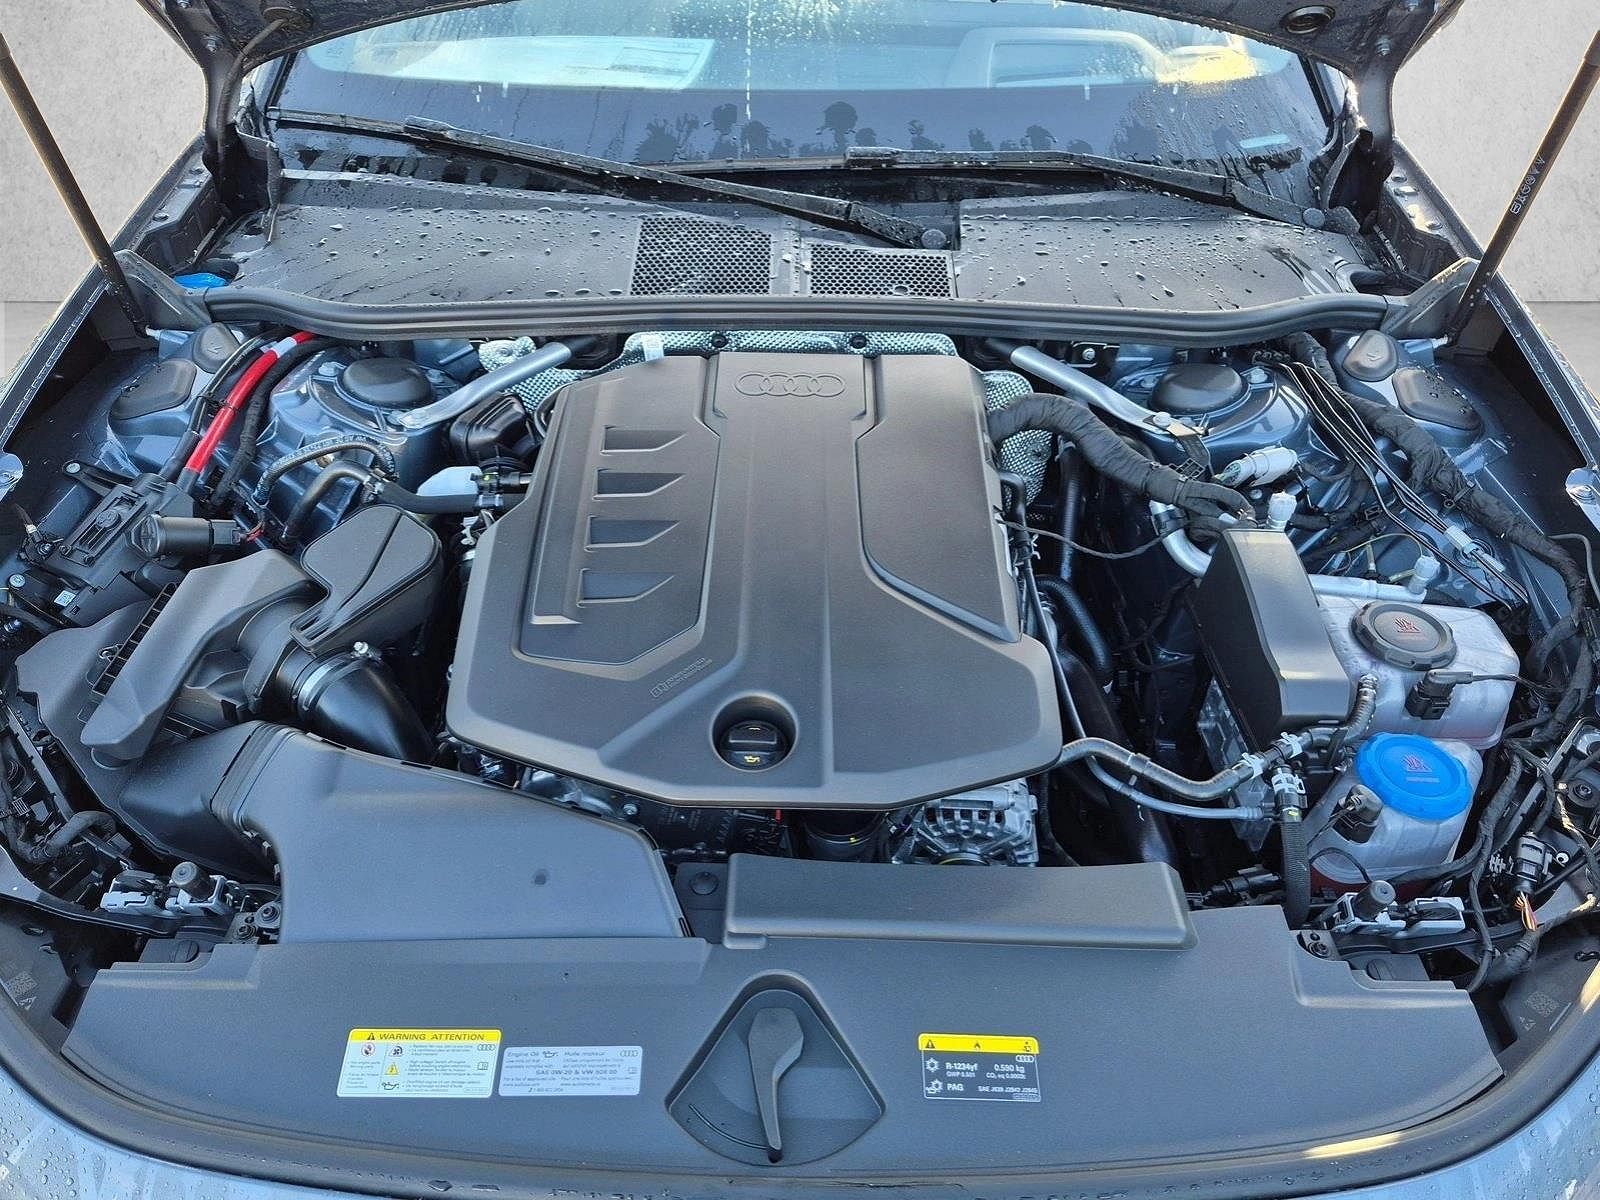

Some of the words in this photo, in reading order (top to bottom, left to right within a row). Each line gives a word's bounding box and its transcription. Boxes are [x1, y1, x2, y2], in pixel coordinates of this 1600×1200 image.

[379, 1033, 426, 1041] WARNING
[430, 1033, 485, 1041] ATTENTION
[945, 1062, 978, 1072] R-1234yf
[1016, 1064, 1025, 1073] kg
[947, 1083, 964, 1092] PAG
